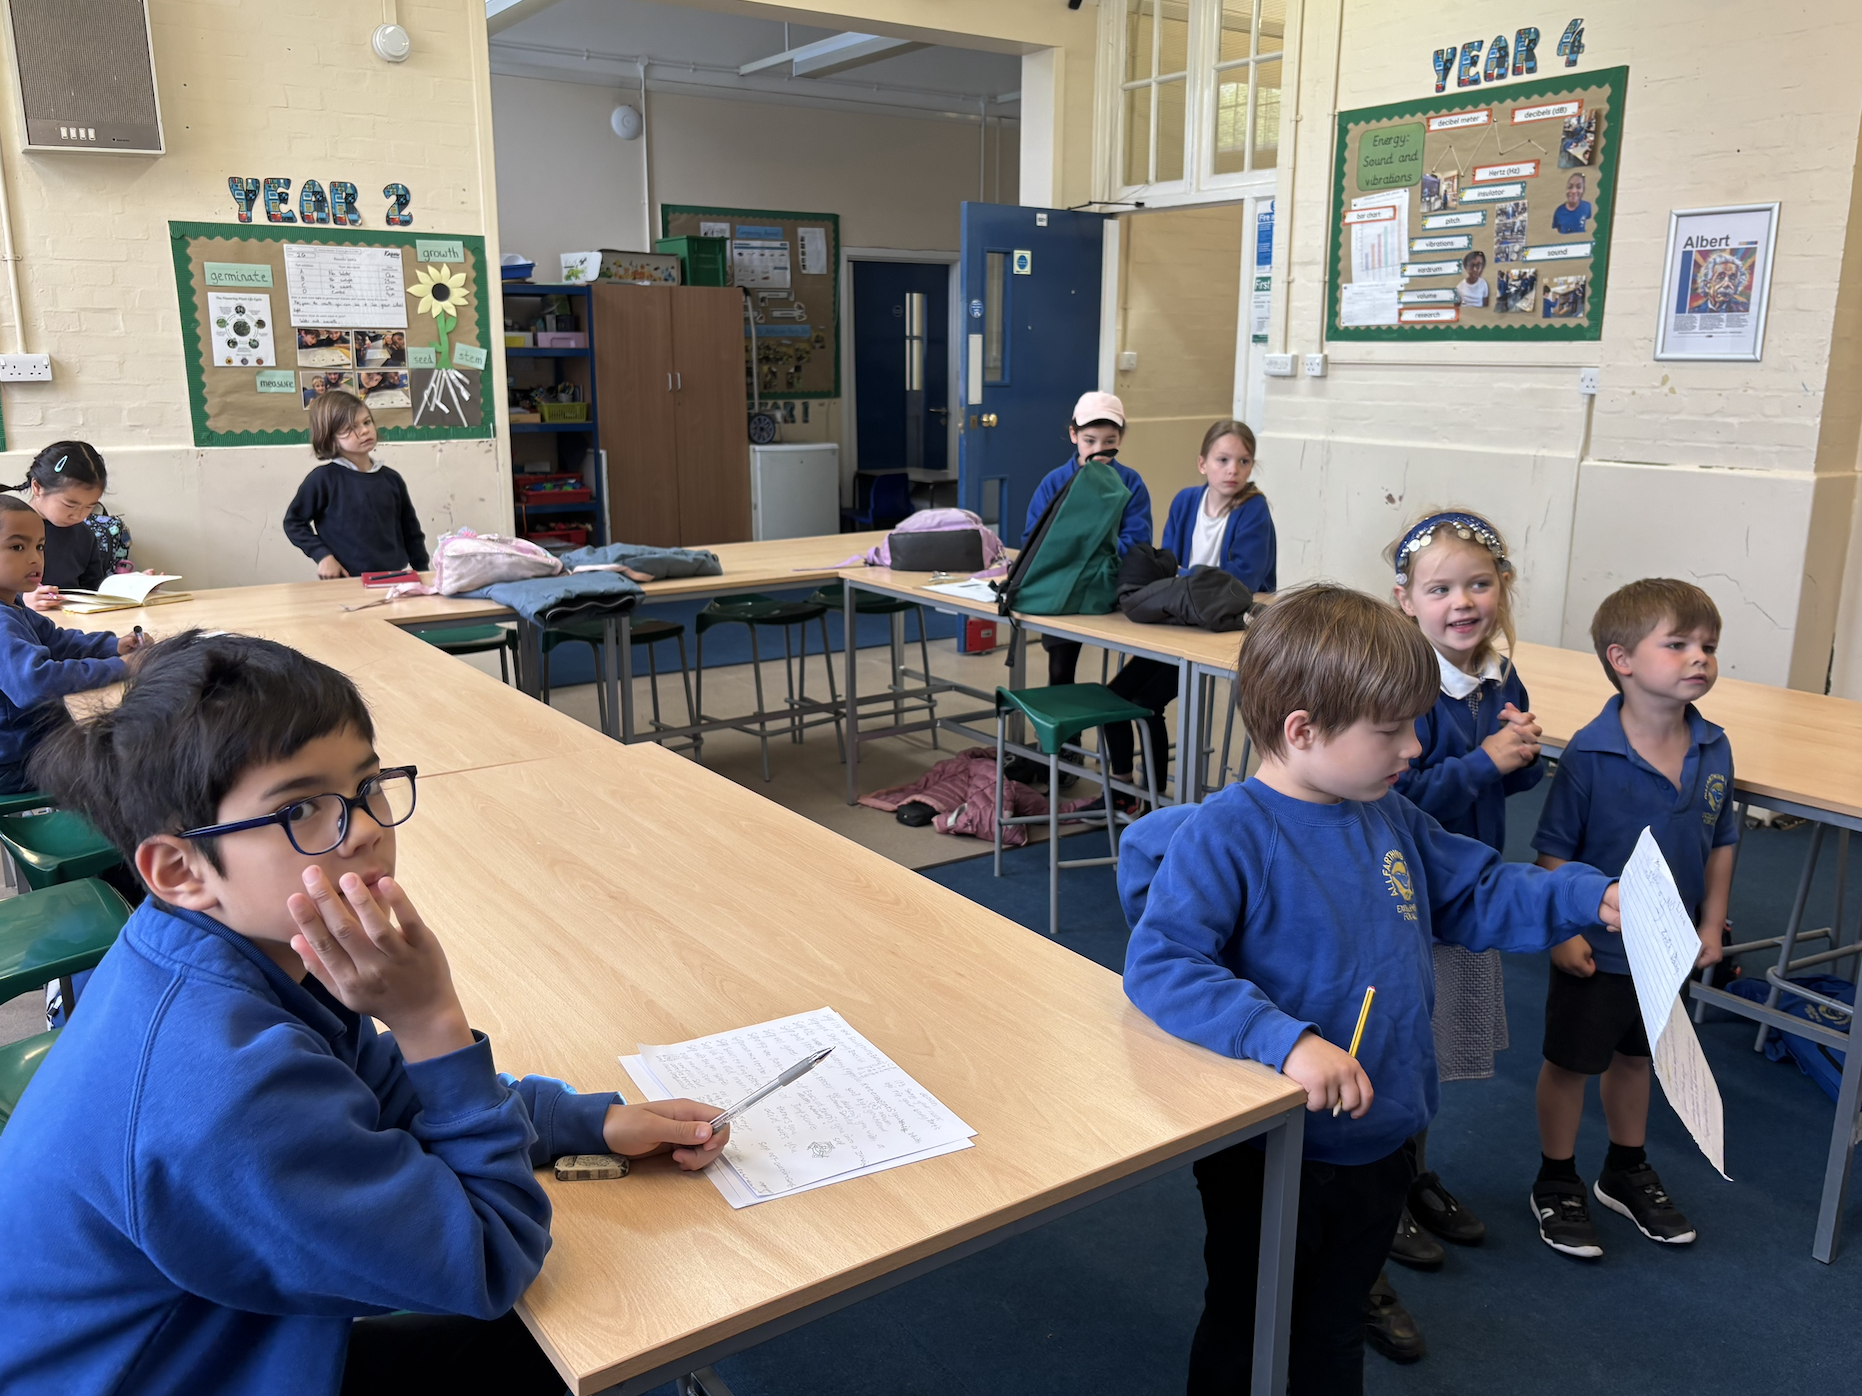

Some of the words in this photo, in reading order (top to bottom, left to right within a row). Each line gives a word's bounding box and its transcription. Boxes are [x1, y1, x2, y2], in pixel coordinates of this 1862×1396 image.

[1433, 27, 1540, 93] YEAR
[1556, 18, 1585, 68] 4
[1524, 109, 1551, 118] decibels
[1552, 106, 1568, 116] (dB)
[1438, 118, 1460, 127] decibel
[1461, 116, 1480, 124] meter
[1372, 134, 1410, 148] Energy:
[1363, 153, 1394, 168] Sound
[1398, 150, 1419, 163] and
[1488, 168, 1506, 177] Hertz
[1365, 173, 1412, 186] vibrations
[1477, 189, 1505, 197] insulator
[228, 176, 362, 226] YEAR
[383, 183, 414, 226] 2
[1683, 234, 1730, 249] Albert
[423, 247, 459, 262] growth
[1548, 248, 1568, 256] sound
[211, 271, 268, 284] germinate
[1255, 281, 1270, 290] First
[414, 355, 434, 364] seed
[459, 350, 484, 364] stem
[260, 380, 294, 389] measure
